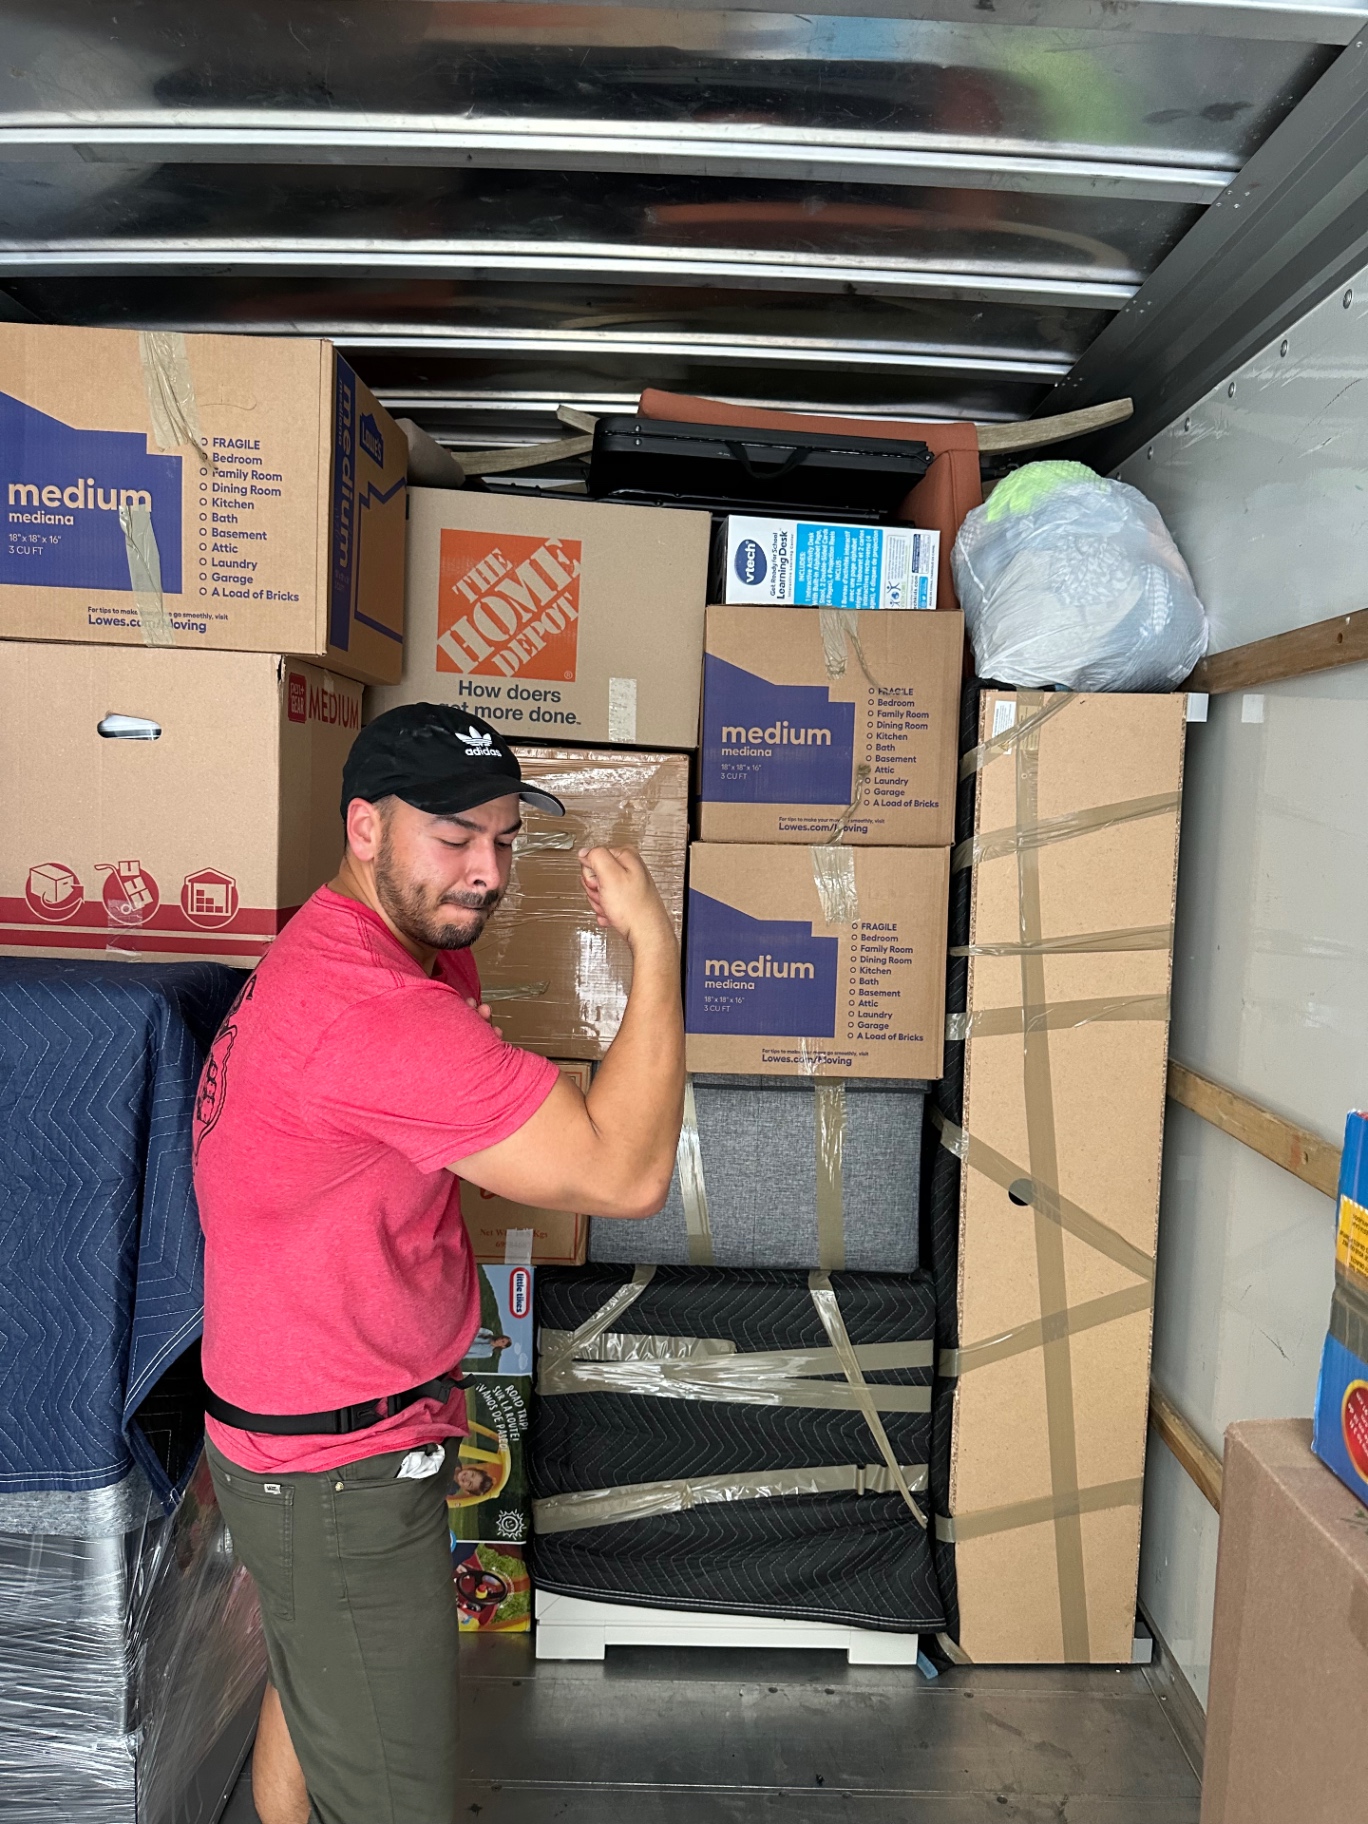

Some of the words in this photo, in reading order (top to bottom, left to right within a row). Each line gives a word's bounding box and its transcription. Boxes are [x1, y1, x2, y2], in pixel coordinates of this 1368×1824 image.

[213, 438, 260, 450] FRAGILE
[213, 453, 262, 465] Bedroom
[212, 467, 248, 482] Family
[252, 470, 282, 482] Room
[338, 384, 353, 567] medium
[9, 479, 151, 511] medium
[212, 482, 248, 496] Dining
[250, 485, 281, 496] Room
[212, 498, 254, 510] Kitchen
[9, 511, 73, 525] mediana
[212, 513, 238, 524] Bath
[212, 528, 267, 540] Basement
[9, 546, 14, 554] 3
[16, 546, 30, 554] CU
[31, 546, 43, 555] FT
[212, 543, 238, 553] Attic
[212, 558, 257, 571] Laundry
[212, 573, 253, 584] Garage
[452, 548, 512, 604] THE
[777, 558, 789, 599] Learning
[212, 588, 219, 597] A
[222, 588, 249, 599] Load
[251, 589, 263, 600] of
[265, 590, 299, 601] Bricks
[437, 538, 581, 674] HOME
[491, 592, 578, 677] DEPOT
[459, 680, 500, 698] How
[507, 684, 561, 702] doers
[309, 685, 358, 730] MEDIUM
[878, 699, 914, 707] Bedroom
[474, 705, 523, 720] more
[877, 710, 904, 719] Family
[877, 721, 903, 730] Dining
[904, 722, 928, 730] Room
[722, 721, 831, 745] medium
[465, 747, 502, 757] adidas
[722, 747, 772, 757] mediana
[875, 755, 916, 763] Basement
[875, 766, 894, 774] Attic
[874, 777, 908, 786] Laundry
[874, 788, 905, 796] Garage
[914, 800, 939, 808] Bricks
[861, 923, 897, 931] FRAGILE
[861, 934, 898, 942] Bedroom
[861, 945, 887, 954] Family
[890, 946, 913, 954] Room
[860, 956, 887, 965] Dining
[889, 957, 912, 965] Room
[705, 956, 814, 979] medium
[860, 967, 891, 975] Kitchen
[705, 980, 755, 990] mediana
[859, 989, 900, 997] Basement
[858, 1011, 892, 1020] Laundry
[858, 1022, 889, 1030] Garage
[898, 1033, 923, 1041] Bricks
[492, 1385, 505, 1401] SUR
[505, 1385, 524, 1407] ROAD
[500, 1400, 512, 1412] LA
[492, 1411, 504, 1423] DE
[505, 1412, 520, 1441] ROUTE!
